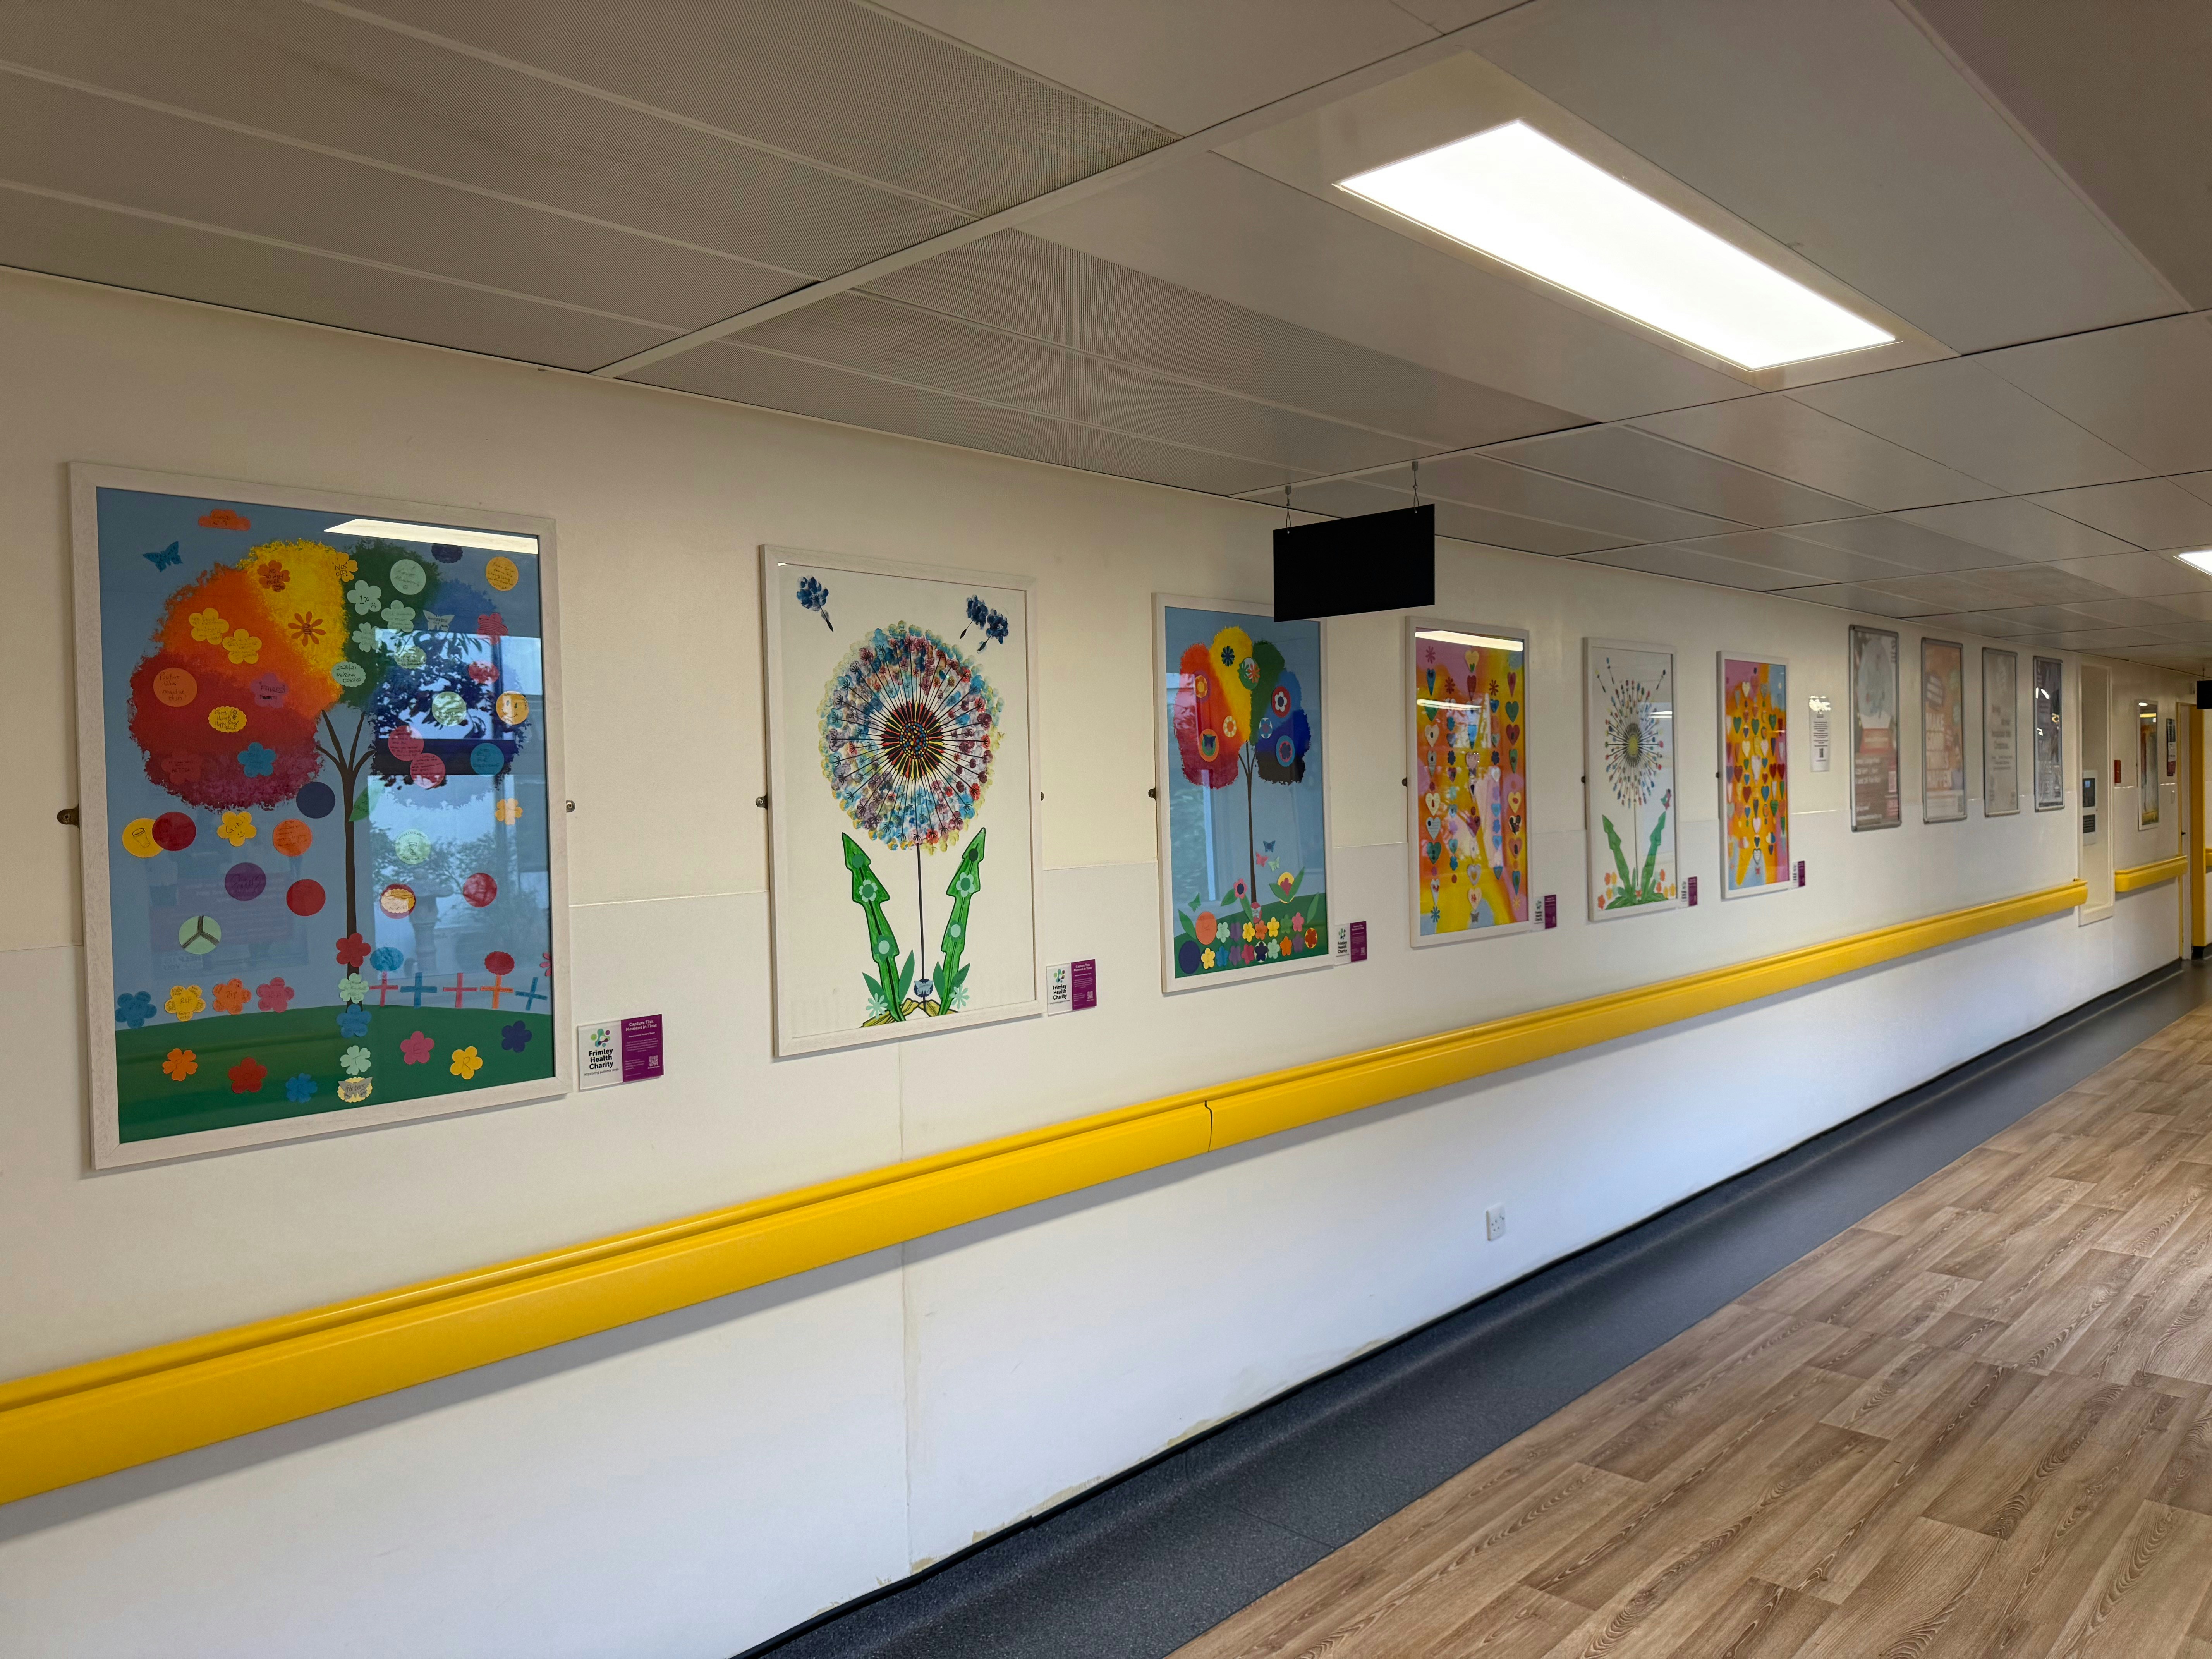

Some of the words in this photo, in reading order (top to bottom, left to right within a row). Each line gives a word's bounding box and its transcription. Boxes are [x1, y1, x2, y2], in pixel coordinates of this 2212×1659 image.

[359, 595, 369, 605] 1%
[589, 1048, 613, 1057] Frimley
[462, 1056, 471, 1070] R
[590, 1054, 612, 1063] Health
[589, 1061, 613, 1070] Charity
